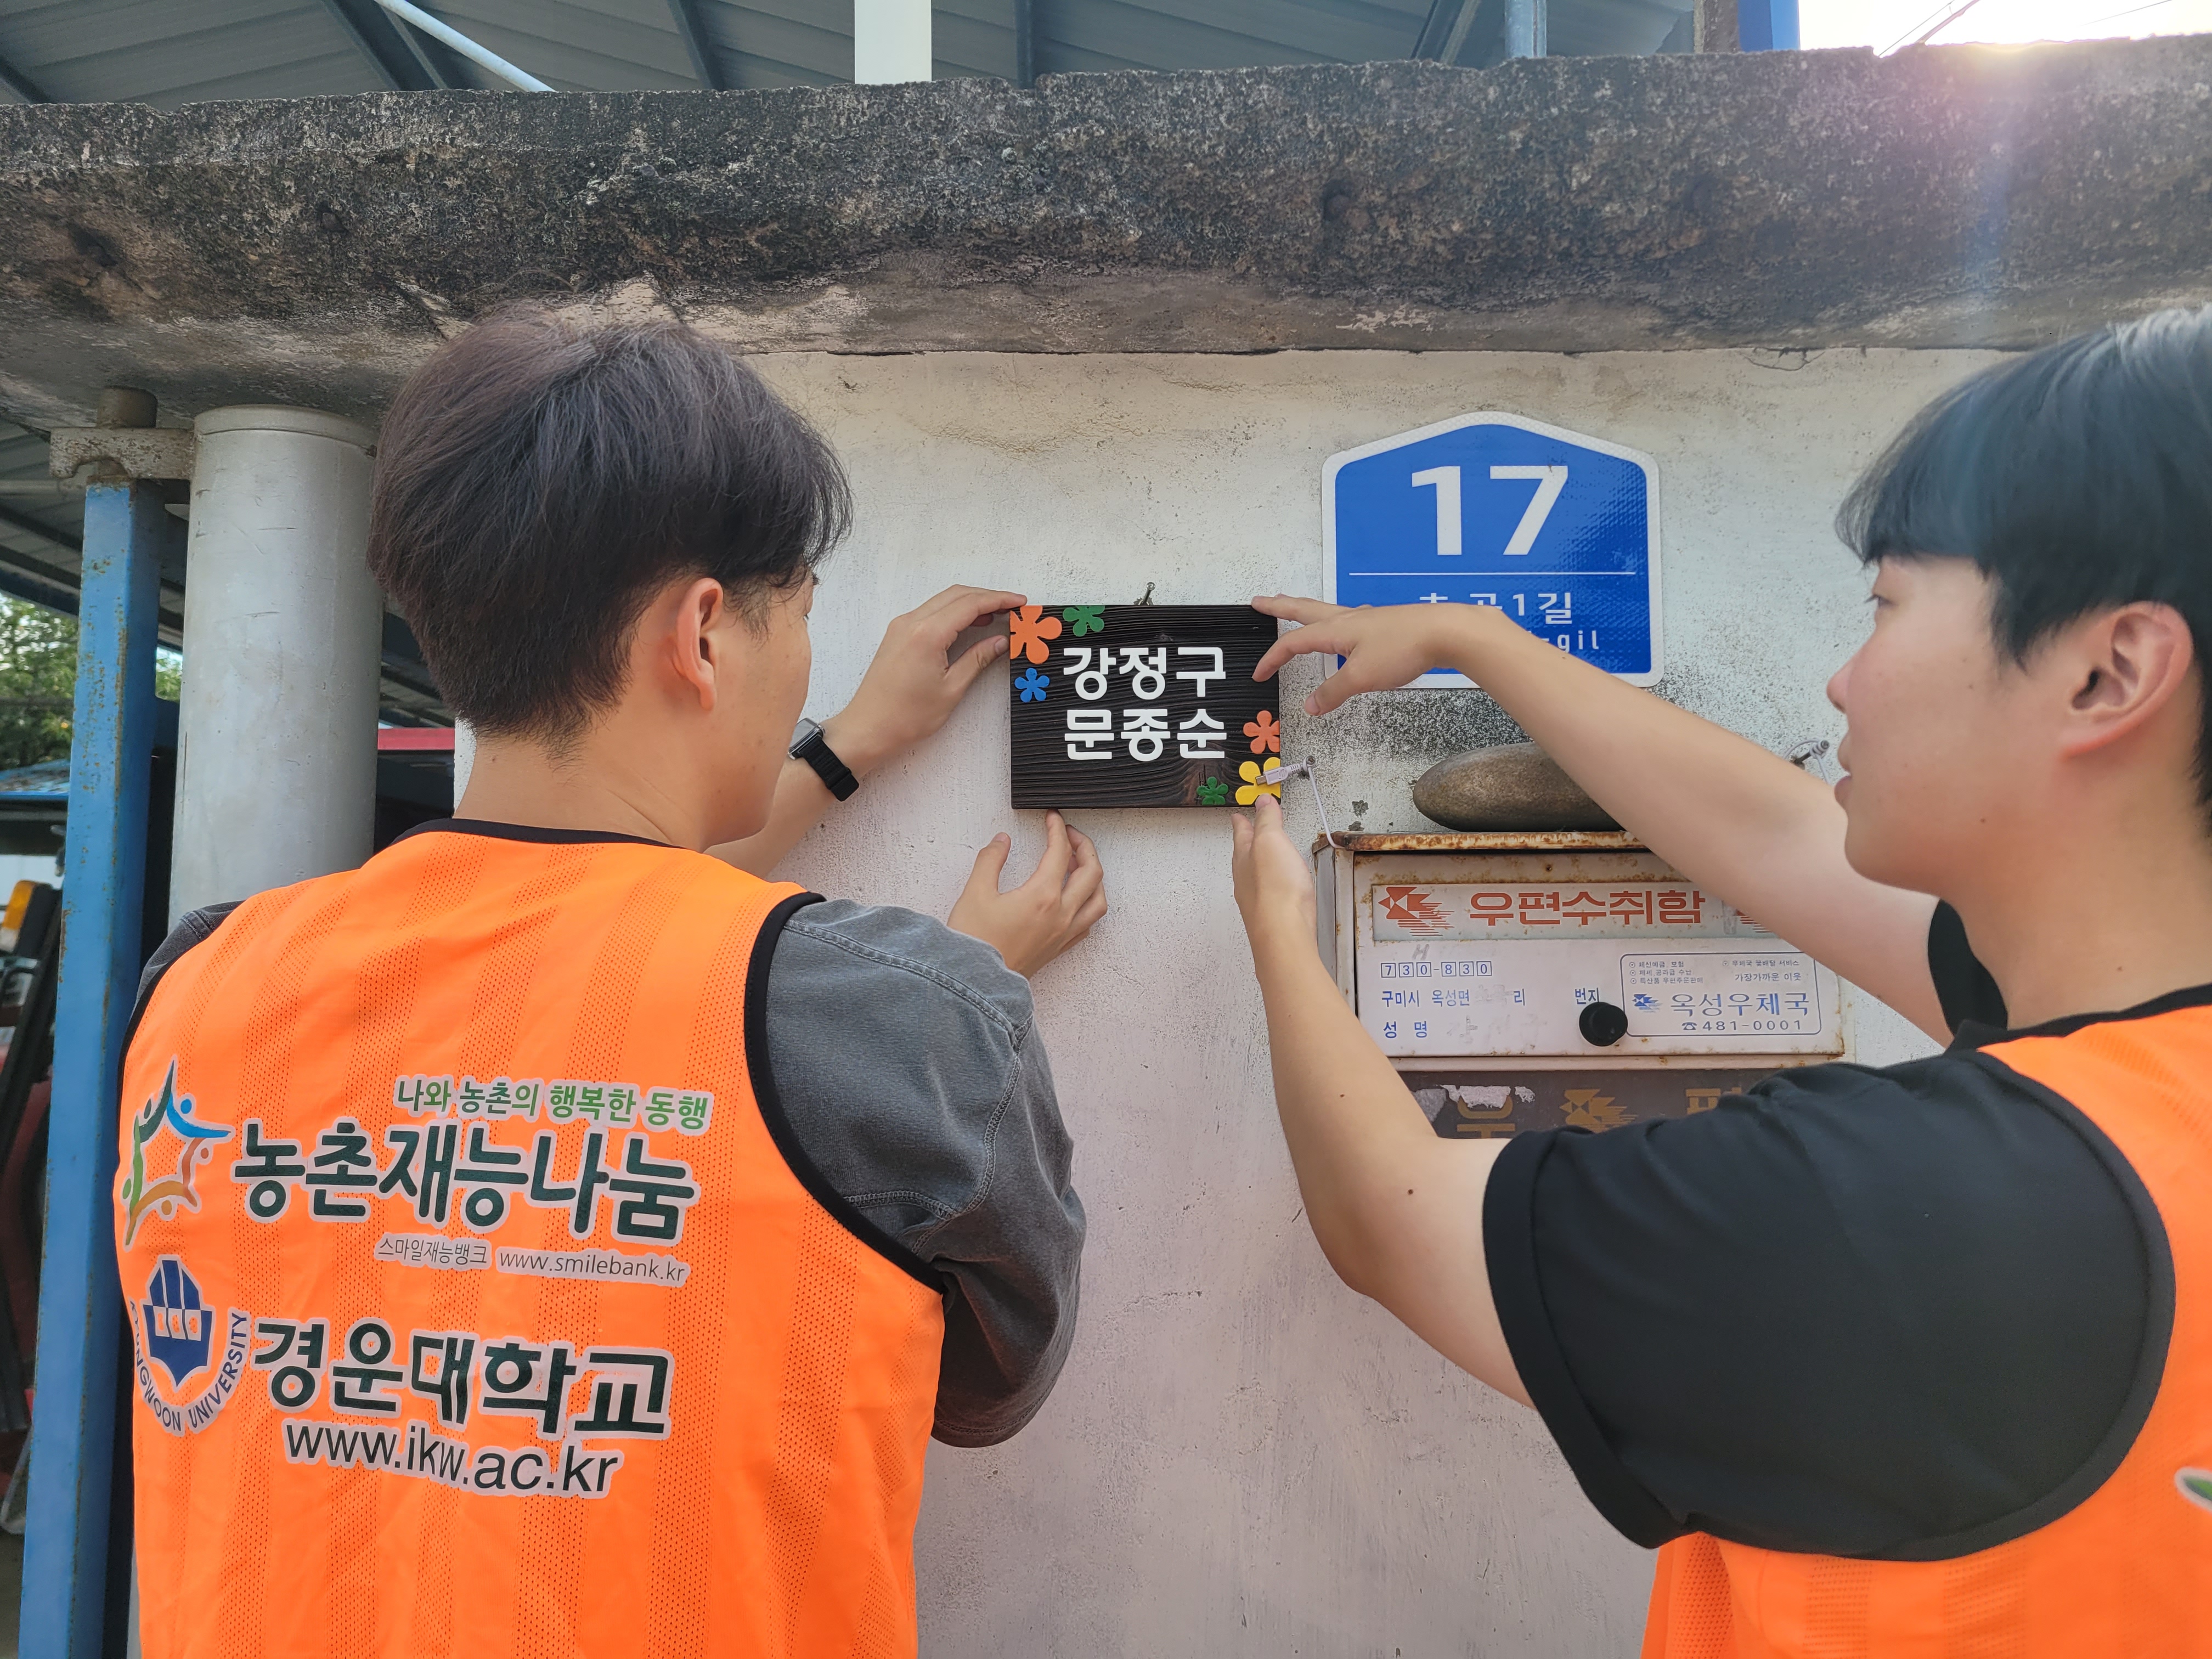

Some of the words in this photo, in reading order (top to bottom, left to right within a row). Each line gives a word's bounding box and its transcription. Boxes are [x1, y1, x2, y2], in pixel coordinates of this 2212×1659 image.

[1412, 466, 1568, 555] 17
[1527, 630, 1599, 653] -gil
[1063, 647, 1227, 701] 강정구
[1064, 708, 1227, 762] 문종순
[1470, 890, 1706, 926] 우편수취함
[1383, 963, 1489, 977] 730-830
[1734, 973, 1780, 982] 가장가까운
[1784, 973, 1802, 981] 이웃
[1381, 989, 1420, 1007] 구미시
[1431, 989, 1470, 1007] 옥성면
[1514, 989, 1525, 1006] 리
[1575, 988, 1600, 1005] 번지
[1671, 993, 1809, 1017] 옥성우체국
[1702, 1020, 1802, 1031] 481-0001
[398, 1079, 452, 1112] 나와
[460, 1081, 540, 1116] 농촌의
[550, 1084, 636, 1122] 행복한
[645, 1092, 708, 1130] 동행
[234, 1122, 695, 1240] 농촌재능나눔
[378, 1238, 488, 1266] 스마일재능뱅크
[500, 1251, 685, 1282] www.smilebank.kr
[188, 1312, 247, 1428] UNIVERSITY
[255, 1322, 669, 1434] 경운대학교
[286, 1424, 619, 1492] www.ikw.ac.kr
